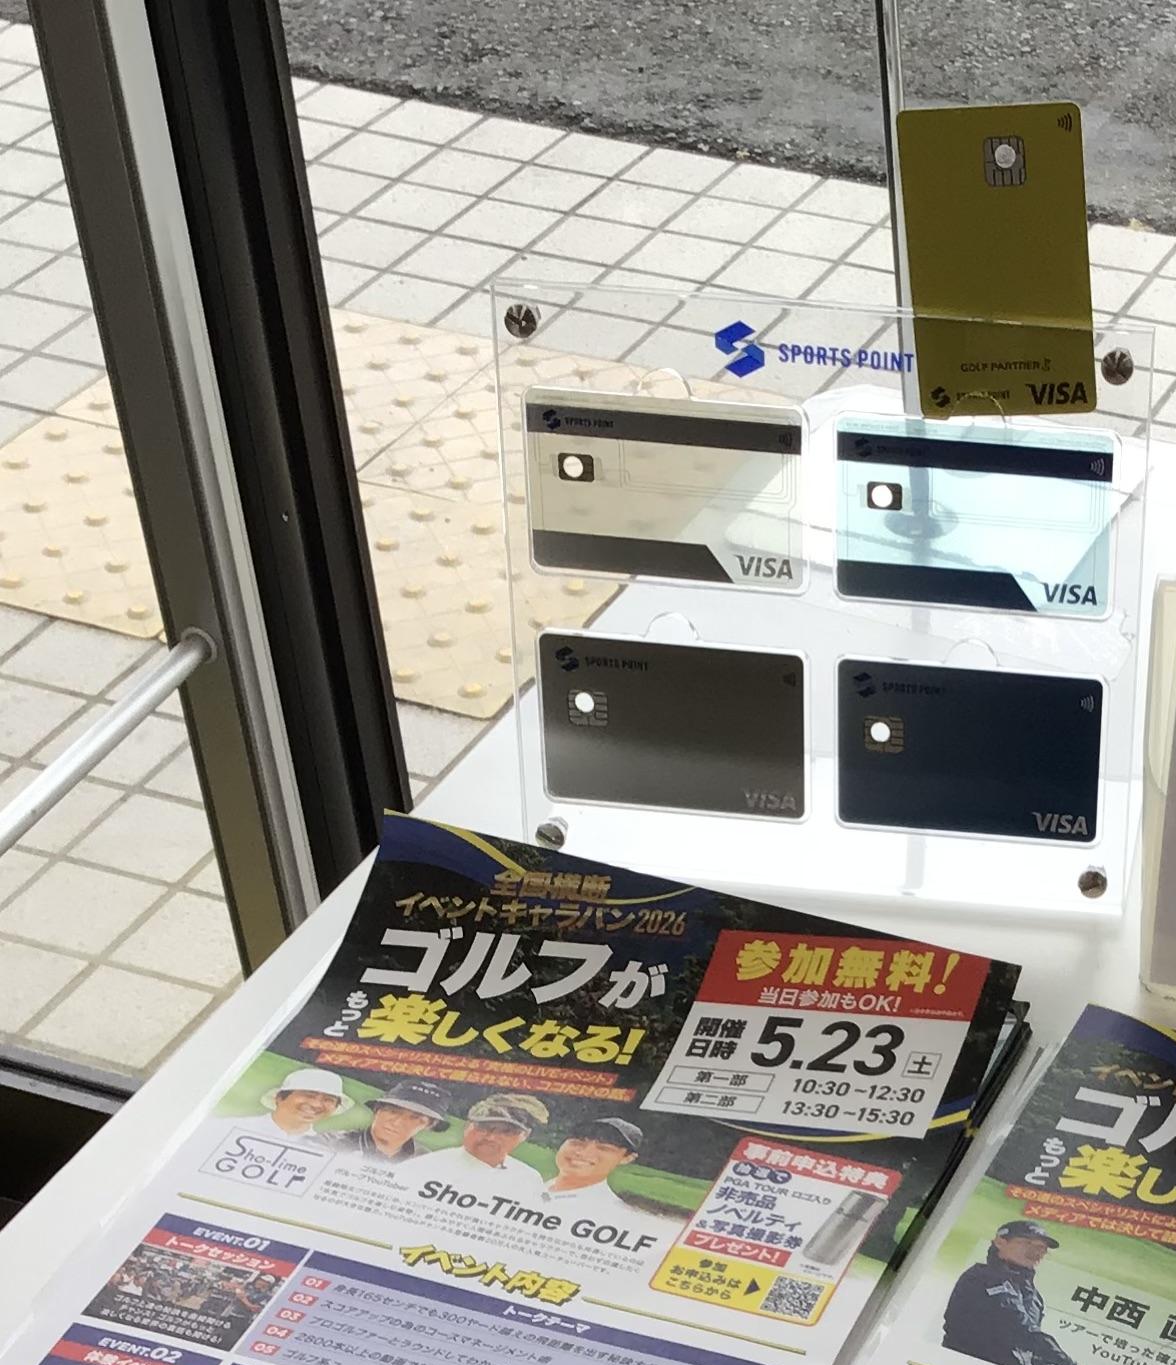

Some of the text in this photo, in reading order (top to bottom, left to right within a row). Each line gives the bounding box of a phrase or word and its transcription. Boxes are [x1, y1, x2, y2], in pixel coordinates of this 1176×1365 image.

[778, 341, 915, 373] SPORTS POINT
[1026, 382, 1087, 405] VISA
[735, 555, 793, 580] VISA
[1041, 583, 1098, 607] VISA
[742, 788, 797, 812] VISA
[1032, 811, 1088, 836] VISA
[396, 892, 688, 936] イベントキャラバン2026
[360, 926, 668, 1010] ゴルフが
[736, 939, 960, 995] 参加無料!
[758, 986, 901, 1012] 当日参加もOK!
[357, 993, 646, 1065] 楽しくなる!
[694, 1017, 747, 1038] 開催
[685, 1038, 738, 1060] 日時
[750, 1016, 905, 1076] 5.23
[693, 1071, 748, 1086] 第一部
[682, 1092, 738, 1107] 第二部
[743, 1142, 889, 1189] 事前申込特典
[715, 1187, 778, 1211] 非売品
[418, 1180, 658, 1254] Sho-Time GOLF
[707, 1203, 802, 1232] ノベルティ
[192, 1226, 271, 1251] EVENT.01
[693, 1232, 781, 1263] プレゼント!
[165, 1236, 276, 1270] トークセッション
[400, 1245, 584, 1305] イベント内容
[670, 1264, 742, 1289] お申込みは
[666, 1279, 731, 1300] こちらから
[501, 1303, 589, 1333] トークテーマ
[1071, 1284, 1150, 1330] 中西
[97, 1337, 182, 1364] EVENT.02
